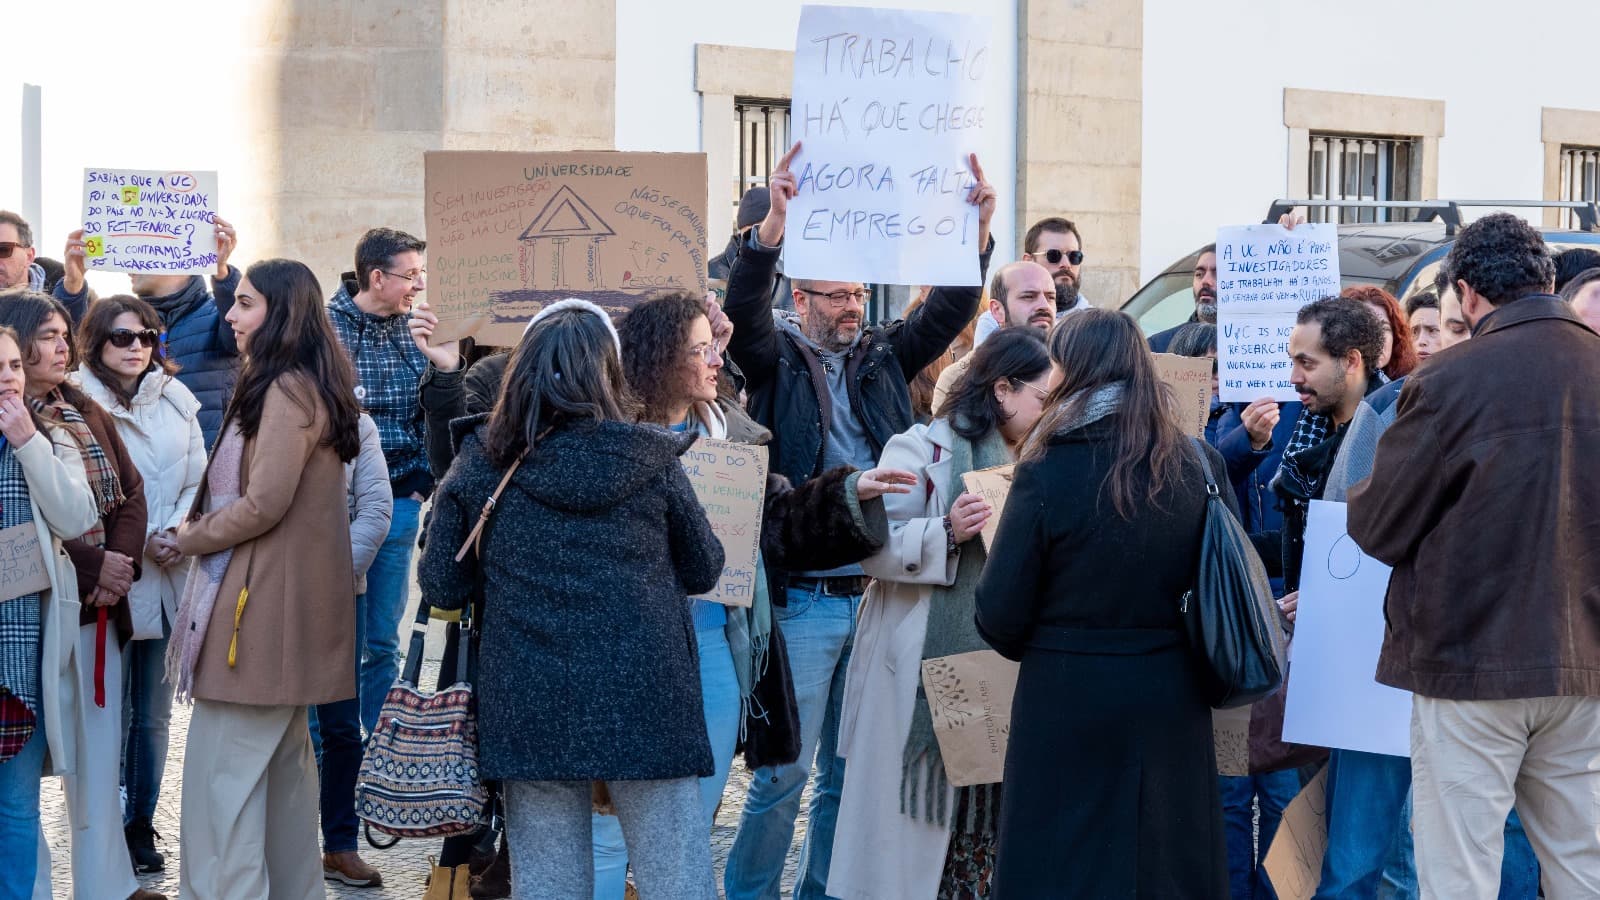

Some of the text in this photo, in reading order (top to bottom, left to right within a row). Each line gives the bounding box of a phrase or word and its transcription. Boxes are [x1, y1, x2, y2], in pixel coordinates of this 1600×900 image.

[811, 32, 988, 81] TRABALHO
[804, 97, 849, 142] HÁ
[861, 100, 910, 137] QUE
[88, 171, 192, 189] SABIAS QUE A UC
[524, 162, 633, 181] UNIVERSIDADE
[798, 162, 894, 195] AGORA
[89, 190, 106, 202] FOI
[140, 192, 209, 208] UNIVERSIDADE
[433, 191, 465, 217] SEM
[630, 185, 661, 203] NÃO
[660, 195, 680, 209] SE
[88, 206, 102, 216] DO
[130, 206, 144, 217] NO
[441, 198, 536, 230] DE QUALIDADE
[85, 221, 101, 233] DO
[125, 244, 192, 260] CONTARMOS
[1223, 244, 1233, 260] A
[1241, 243, 1259, 258] UC
[1267, 239, 1292, 257] NÃO
[1307, 241, 1332, 255] PARA
[113, 256, 160, 271] LUGARES
[436, 252, 514, 272] QUALIDADE
[1227, 258, 1329, 273] INVESTIGADORES
[1220, 280, 1234, 290] QUE
[1238, 277, 1283, 289] TRABALHAM
[1303, 276, 1309, 286] 3
[1232, 293, 1259, 303] SEMANA
[1261, 292, 1274, 301] QUE
[1276, 292, 1289, 301] VEM
[1257, 327, 1270, 337] IS
[1226, 360, 1266, 370] WORKING
[1270, 361, 1287, 370] HERE
[1225, 380, 1243, 389] NEXT
[1247, 380, 1266, 388] WEEK
[1269, 380, 1274, 388] I
[726, 455, 746, 467] DO
[723, 566, 752, 583] GUAIS
